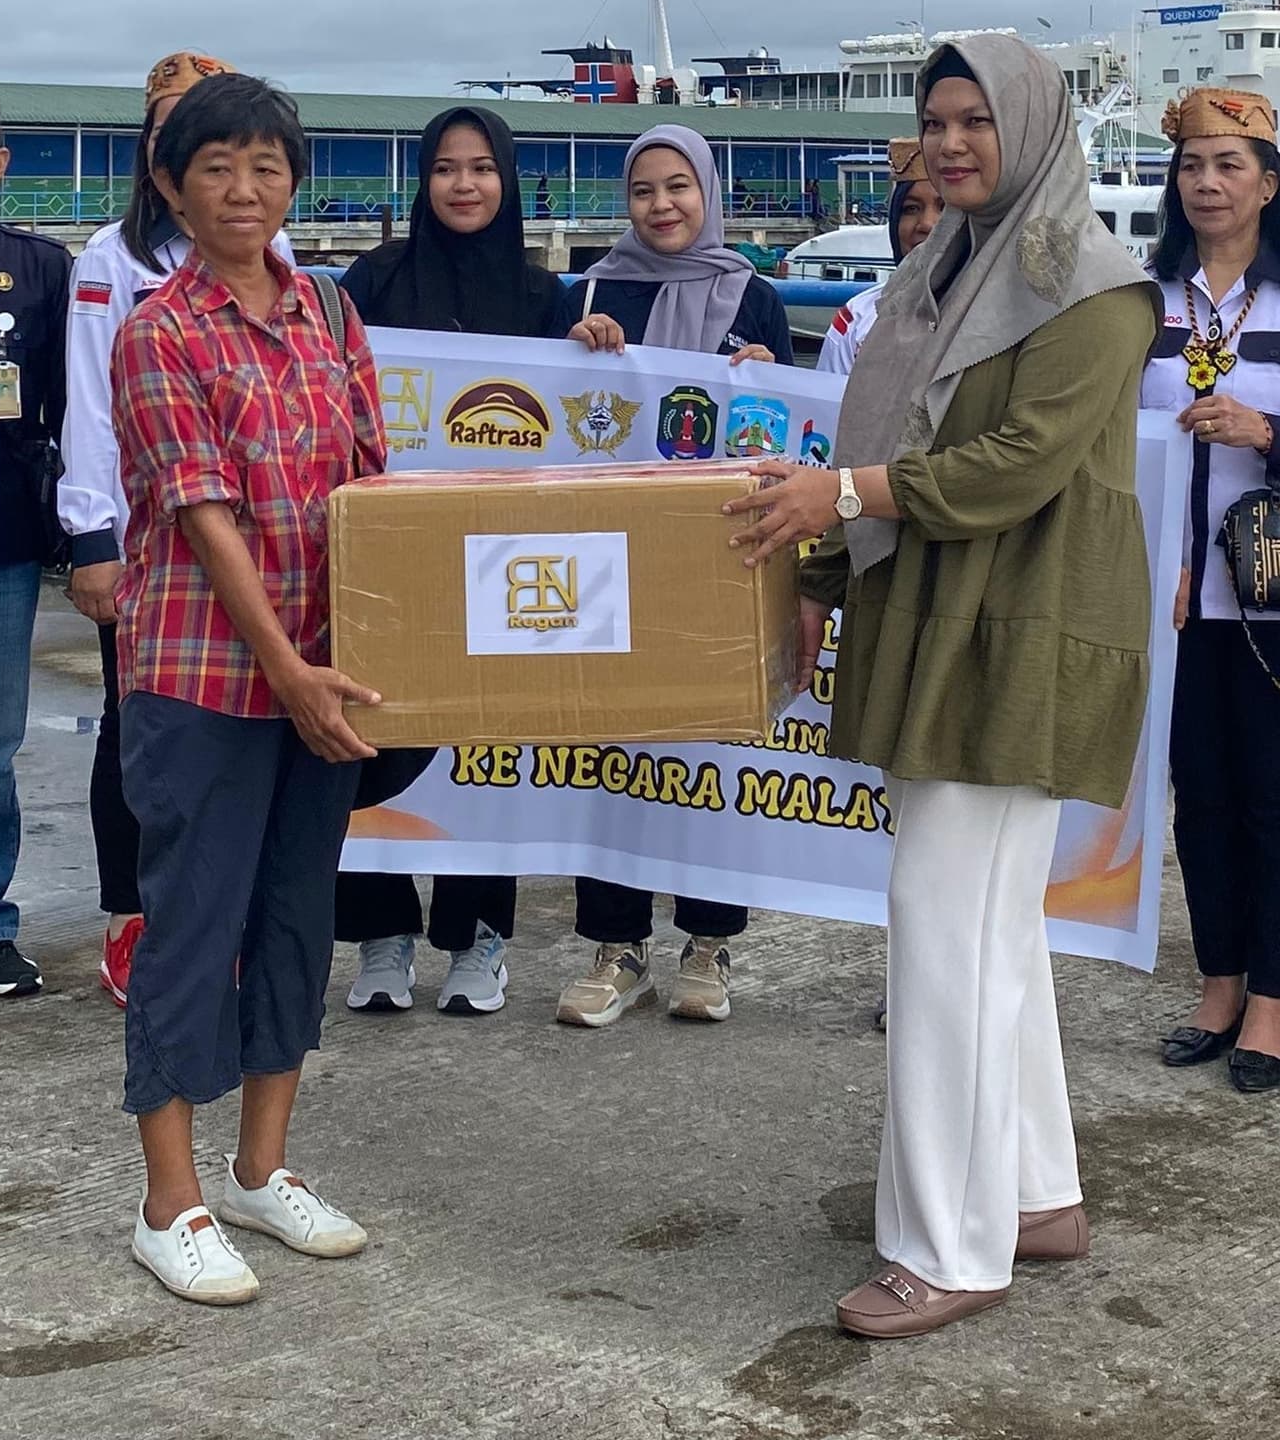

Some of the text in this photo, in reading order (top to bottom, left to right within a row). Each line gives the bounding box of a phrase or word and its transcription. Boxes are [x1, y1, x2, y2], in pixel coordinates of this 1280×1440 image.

[1163, 10, 1196, 21] QUEEN
[449, 421, 543, 449] Raftrasa
[385, 436, 428, 453] egan
[508, 615, 578, 632] Regan
[450, 745, 521, 787] KE
[530, 745, 725, 812] NEGARA
